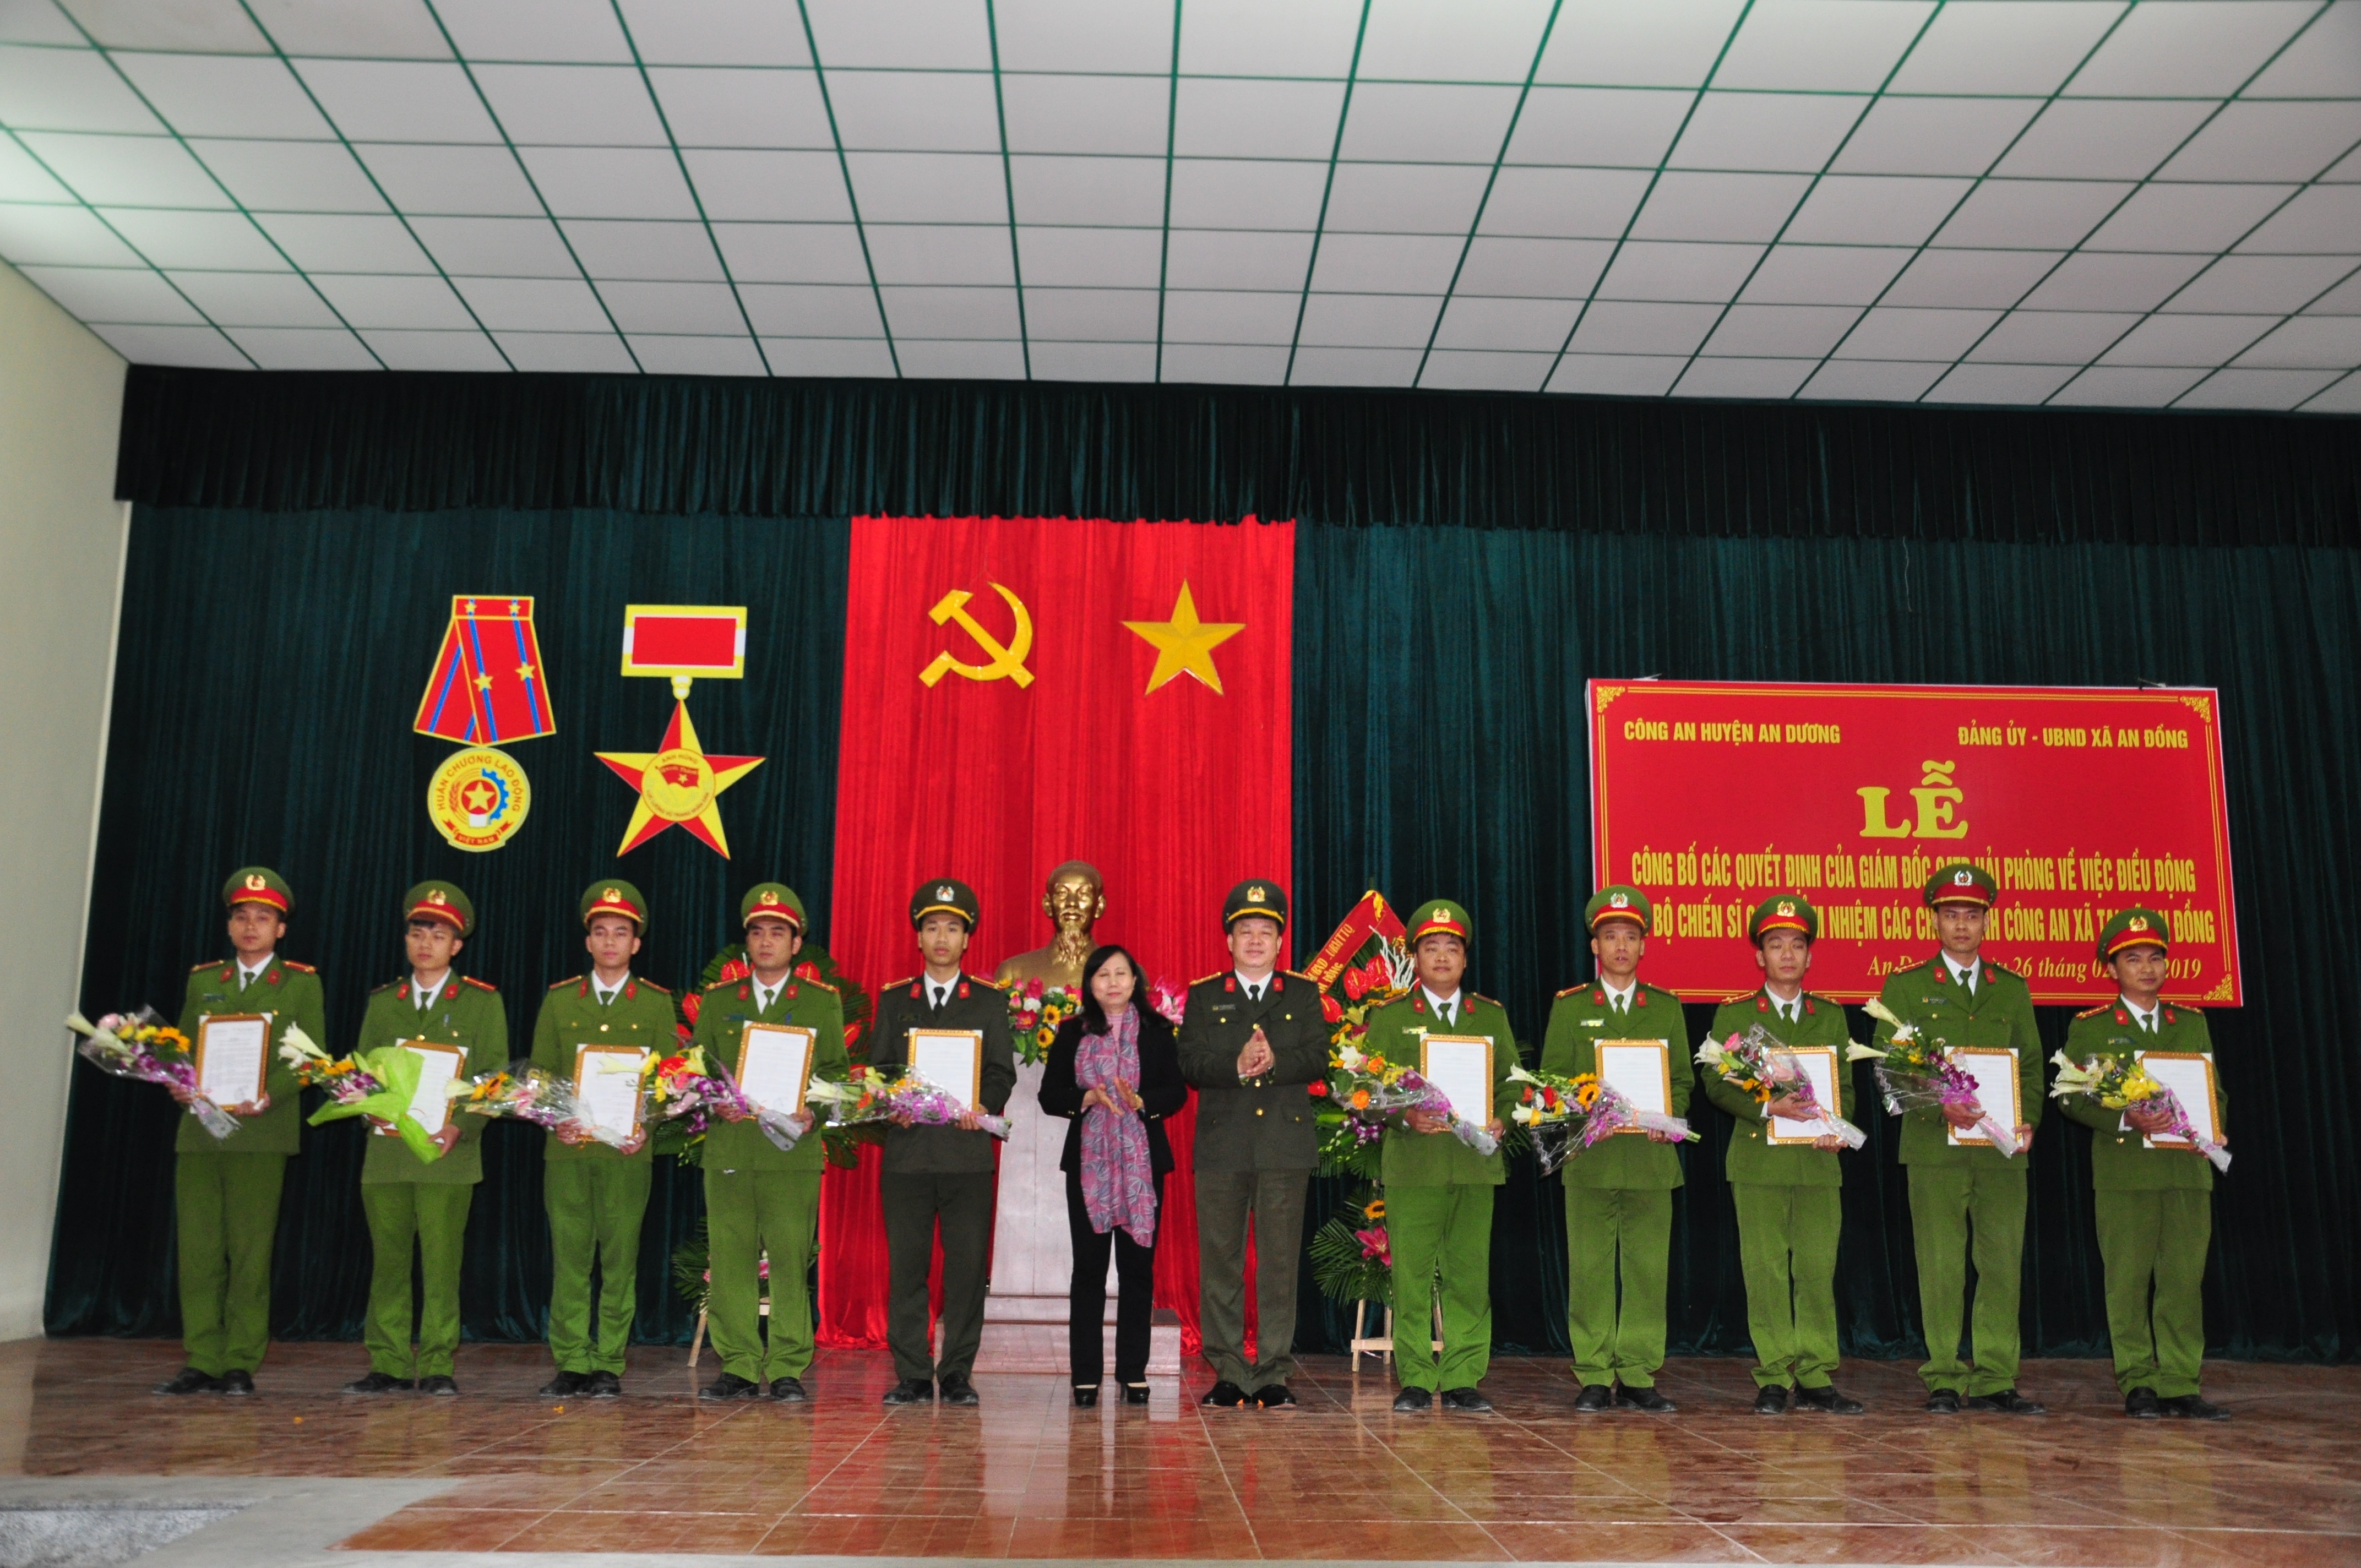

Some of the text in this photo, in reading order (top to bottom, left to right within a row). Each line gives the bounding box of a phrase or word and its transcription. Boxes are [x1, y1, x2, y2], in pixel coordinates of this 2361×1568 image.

[1624, 717, 1841, 746] CÔNG AN HUYỆN AN DƯƠNG
[1958, 719, 2002, 745] ĐẢNG
[2006, 720, 2026, 746] ỦY
[2043, 728, 2086, 747] UBND
[2091, 725, 2113, 747] XÃ
[2118, 729, 2140, 747] AN
[2144, 724, 2188, 748] ĐỒNG
[496, 760, 514, 777] LAO
[1856, 760, 1968, 839] LỄ
[1631, 845, 1673, 886] CÔNG
[1677, 841, 1697, 886] BỐ
[1701, 846, 1731, 886] CÁC
[1736, 843, 1781, 890] QUYẾT
[1785, 854, 1821, 895] ĐỊNH
[1825, 843, 1856, 888] CỦA
[1859, 848, 1898, 888] GIÁM
[1901, 844, 1932, 889] ĐỐC
[2004, 849, 2055, 890] PHÒNG
[2058, 847, 2077, 890] VỀ
[2080, 851, 2113, 898] VIỆC
[2117, 848, 2151, 891] ĐIỀU
[2155, 852, 2196, 899] ĐỘNG
[1653, 896, 1673, 945] BỘ
[1678, 894, 1723, 938] CHIẾN
[1727, 898, 1742, 938] SĨ
[1829, 899, 1878, 947] NHIỆM
[1881, 900, 1912, 940] CÁC
[2004, 901, 2045, 941] CÔNG
[2049, 908, 2070, 941] AN
[2073, 902, 2095, 941] XÃ
[2173, 899, 2215, 943] ĐỒNG
[1867, 956, 1892, 976] An
[2013, 956, 2033, 977] 26
[2038, 957, 2087, 983] tháng
